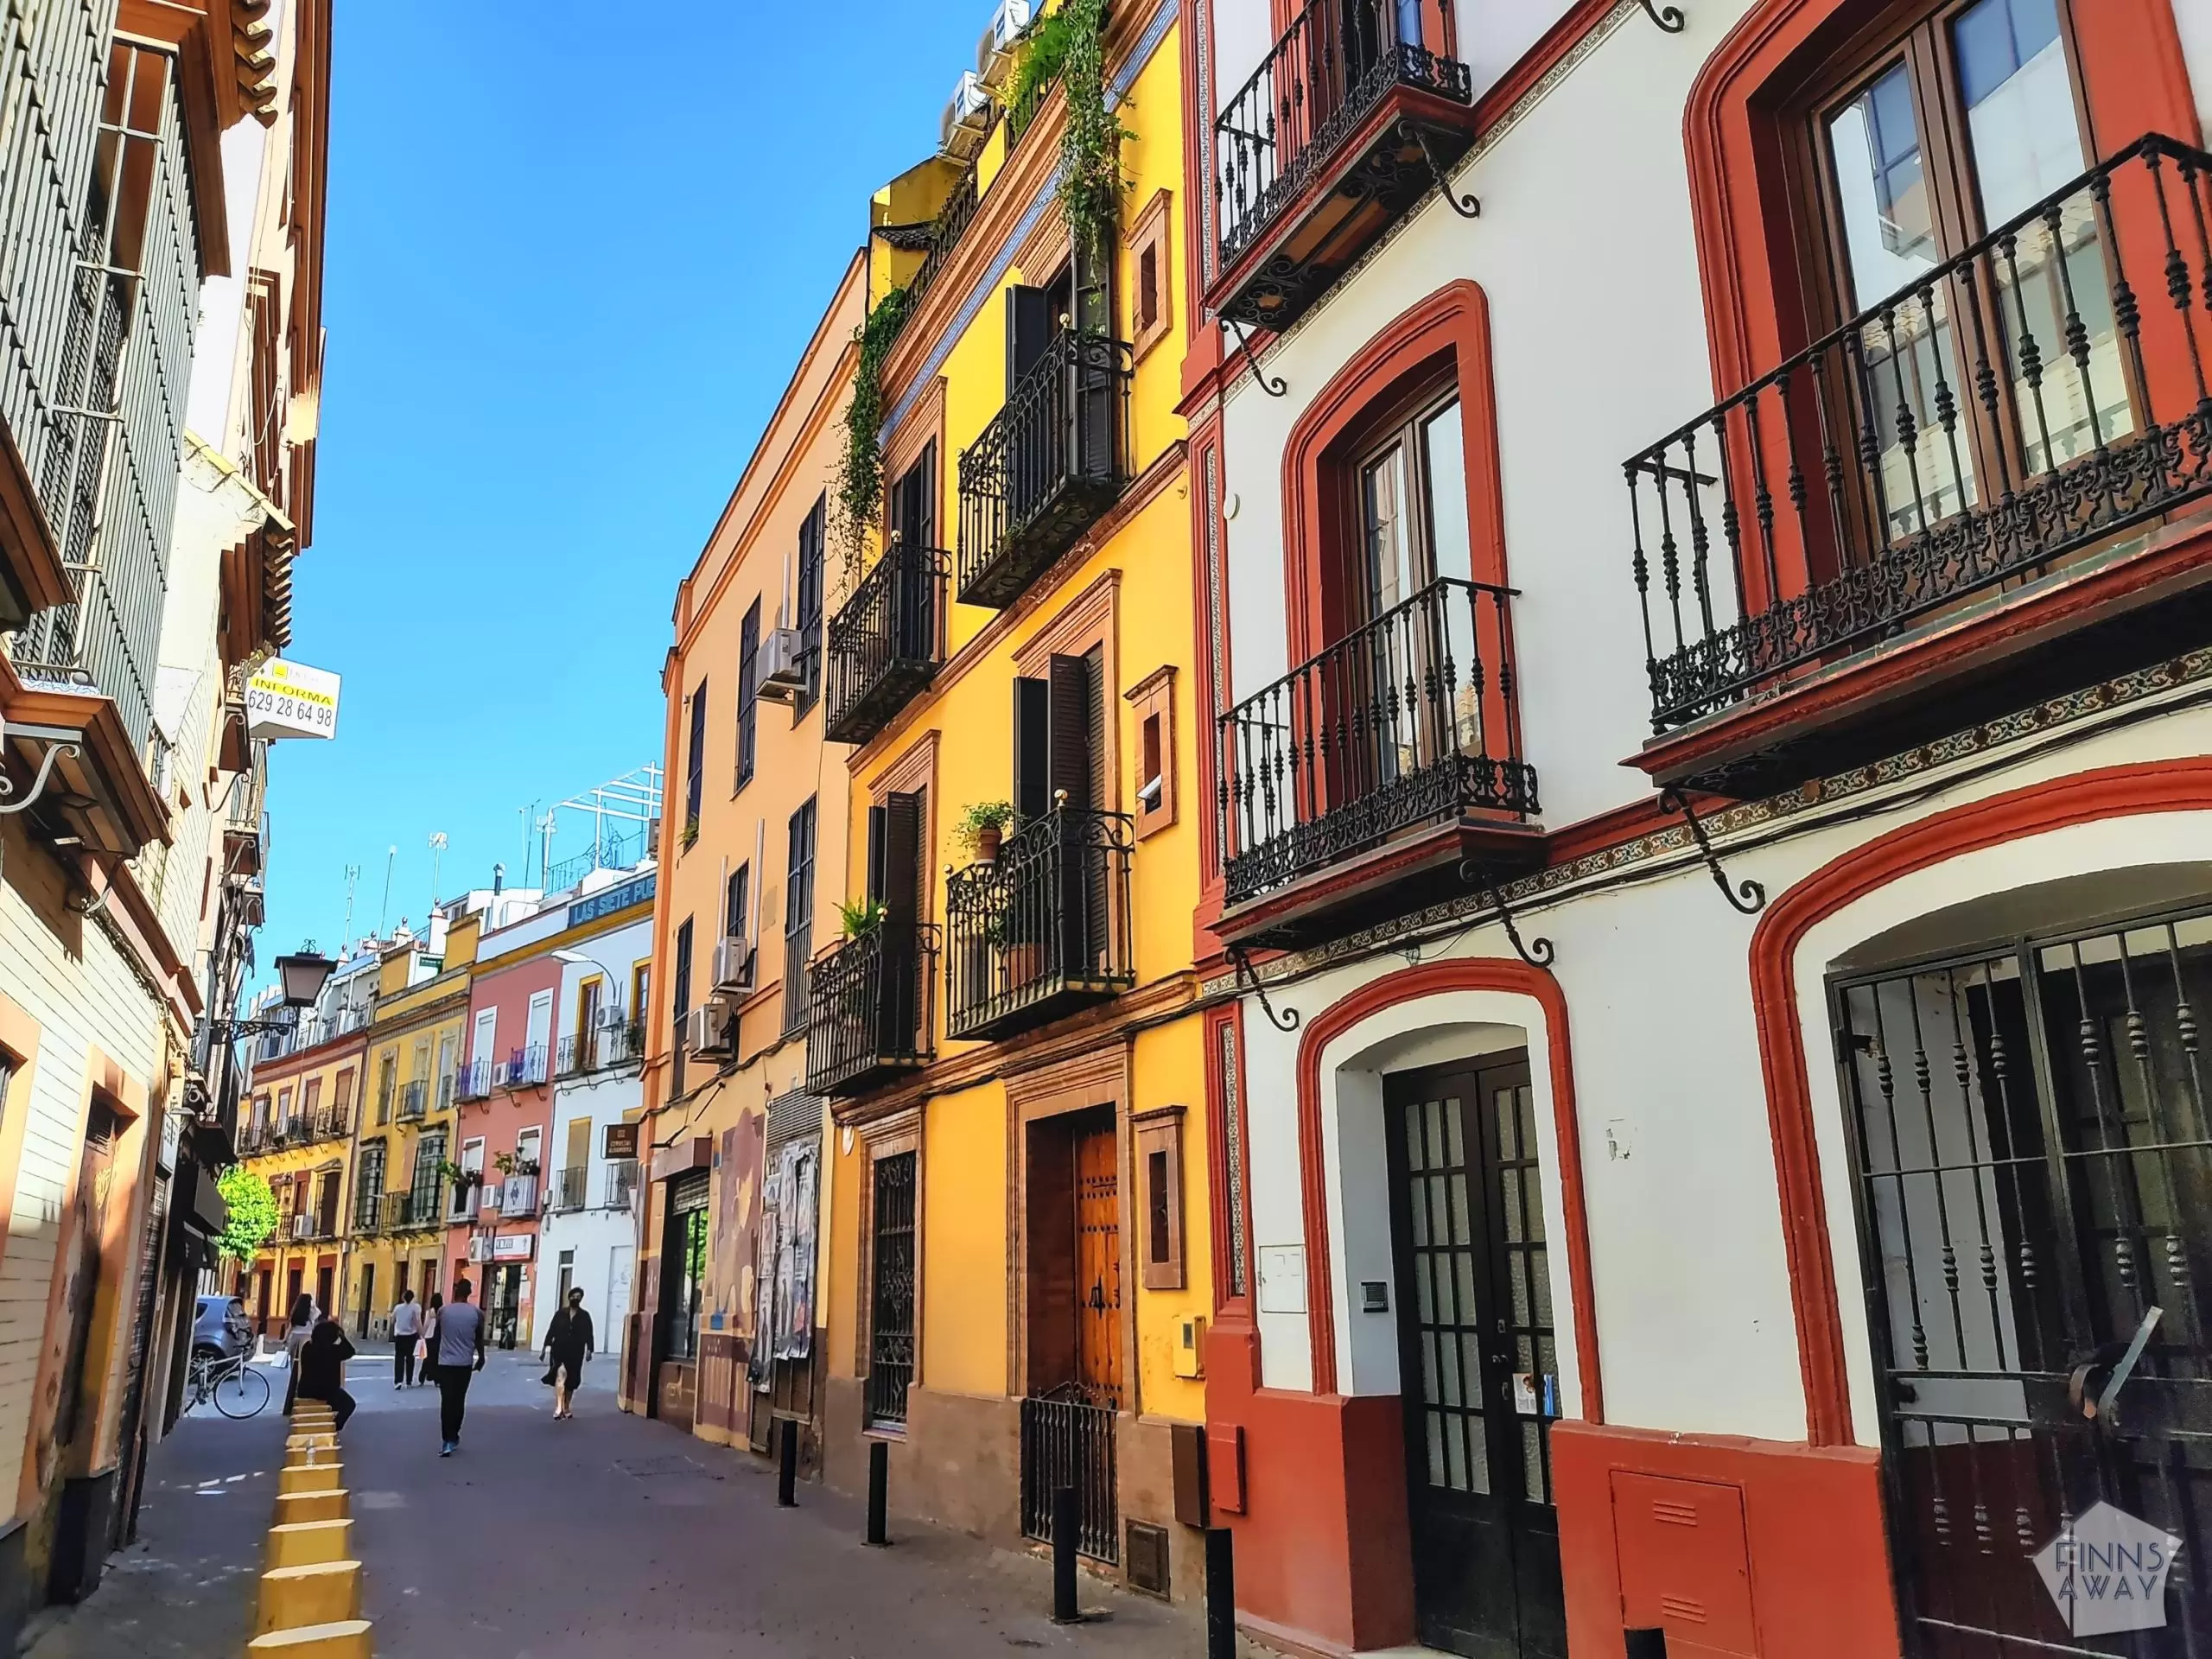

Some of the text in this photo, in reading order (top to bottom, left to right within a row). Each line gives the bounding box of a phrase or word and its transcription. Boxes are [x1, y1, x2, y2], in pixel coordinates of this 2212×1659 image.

[249, 690, 333, 727] 629 28 64 98
[255, 678, 332, 705] INFORMA
[574, 900, 594, 925] LAS
[598, 887, 630, 916] SIETE
